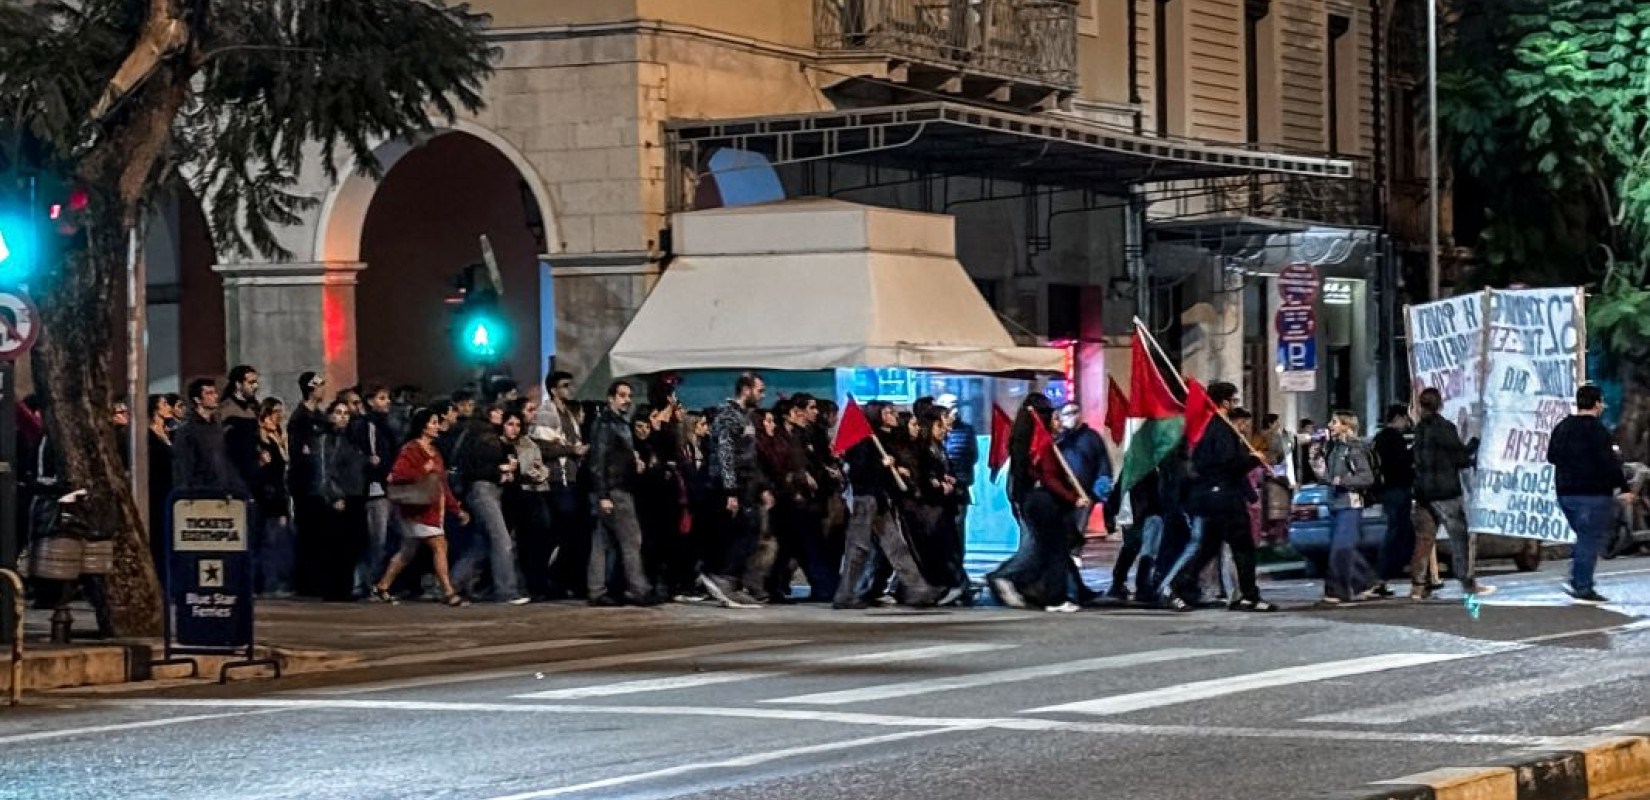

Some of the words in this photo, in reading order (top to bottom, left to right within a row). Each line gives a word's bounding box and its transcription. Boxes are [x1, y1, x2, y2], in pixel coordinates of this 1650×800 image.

[186, 517, 234, 529] TICKETS
[185, 593, 212, 605] Blue
[213, 593, 238, 605] Star
[191, 606, 232, 618] Ferries
